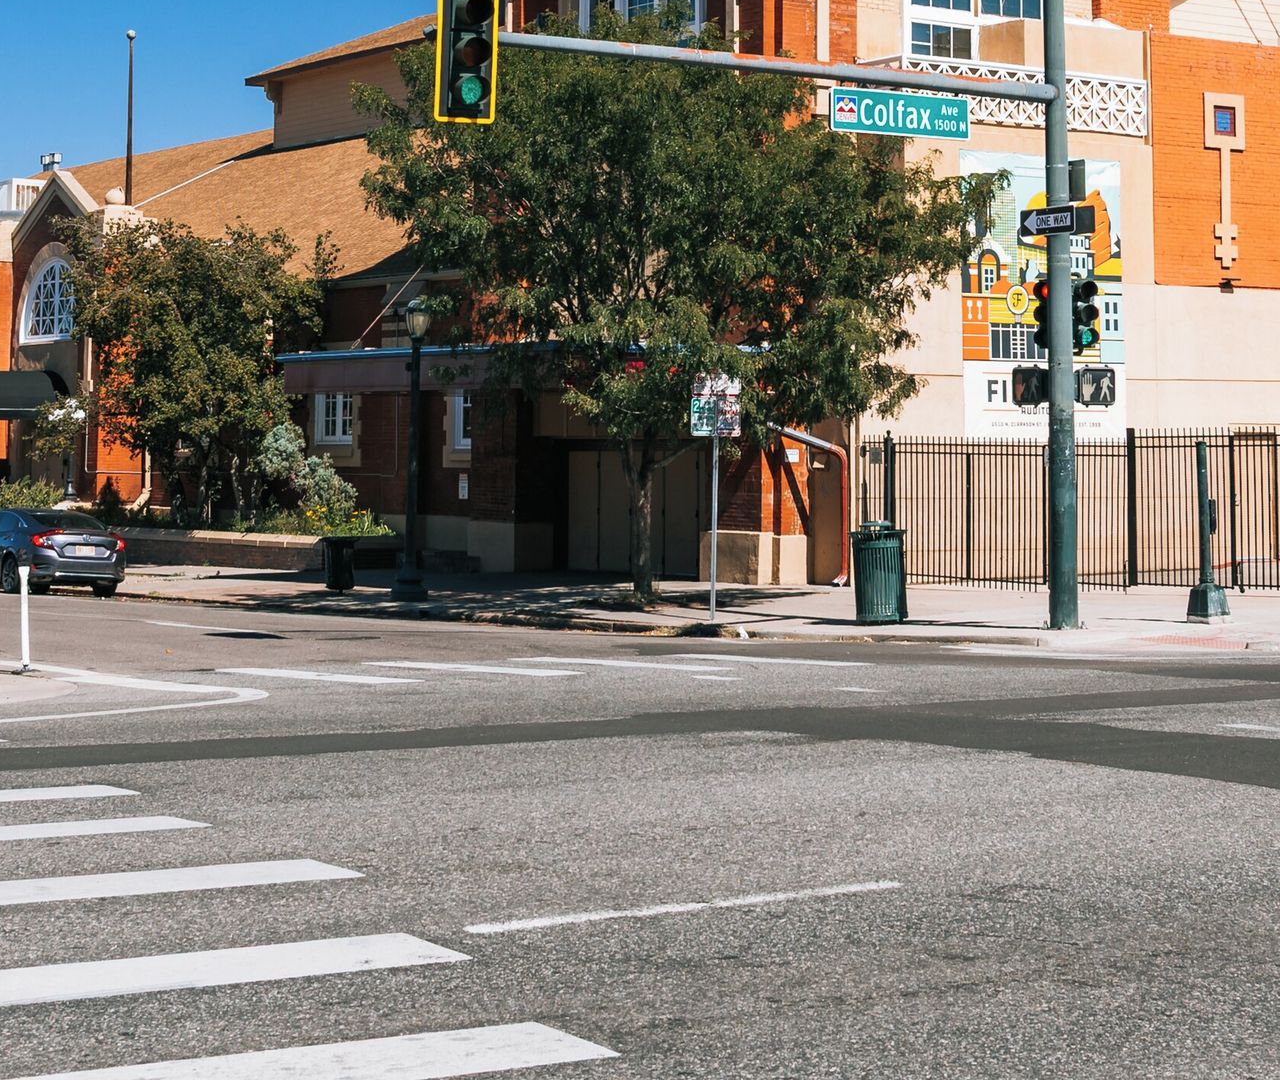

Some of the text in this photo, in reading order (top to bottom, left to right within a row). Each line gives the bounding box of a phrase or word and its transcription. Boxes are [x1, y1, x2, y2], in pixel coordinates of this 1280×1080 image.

[860, 98, 959, 130] Colfax Ave
[933, 119, 967, 133] 1500 N
[1035, 213, 1069, 228] ONE WAY
[1021, 406, 1050, 415] AUDITO
